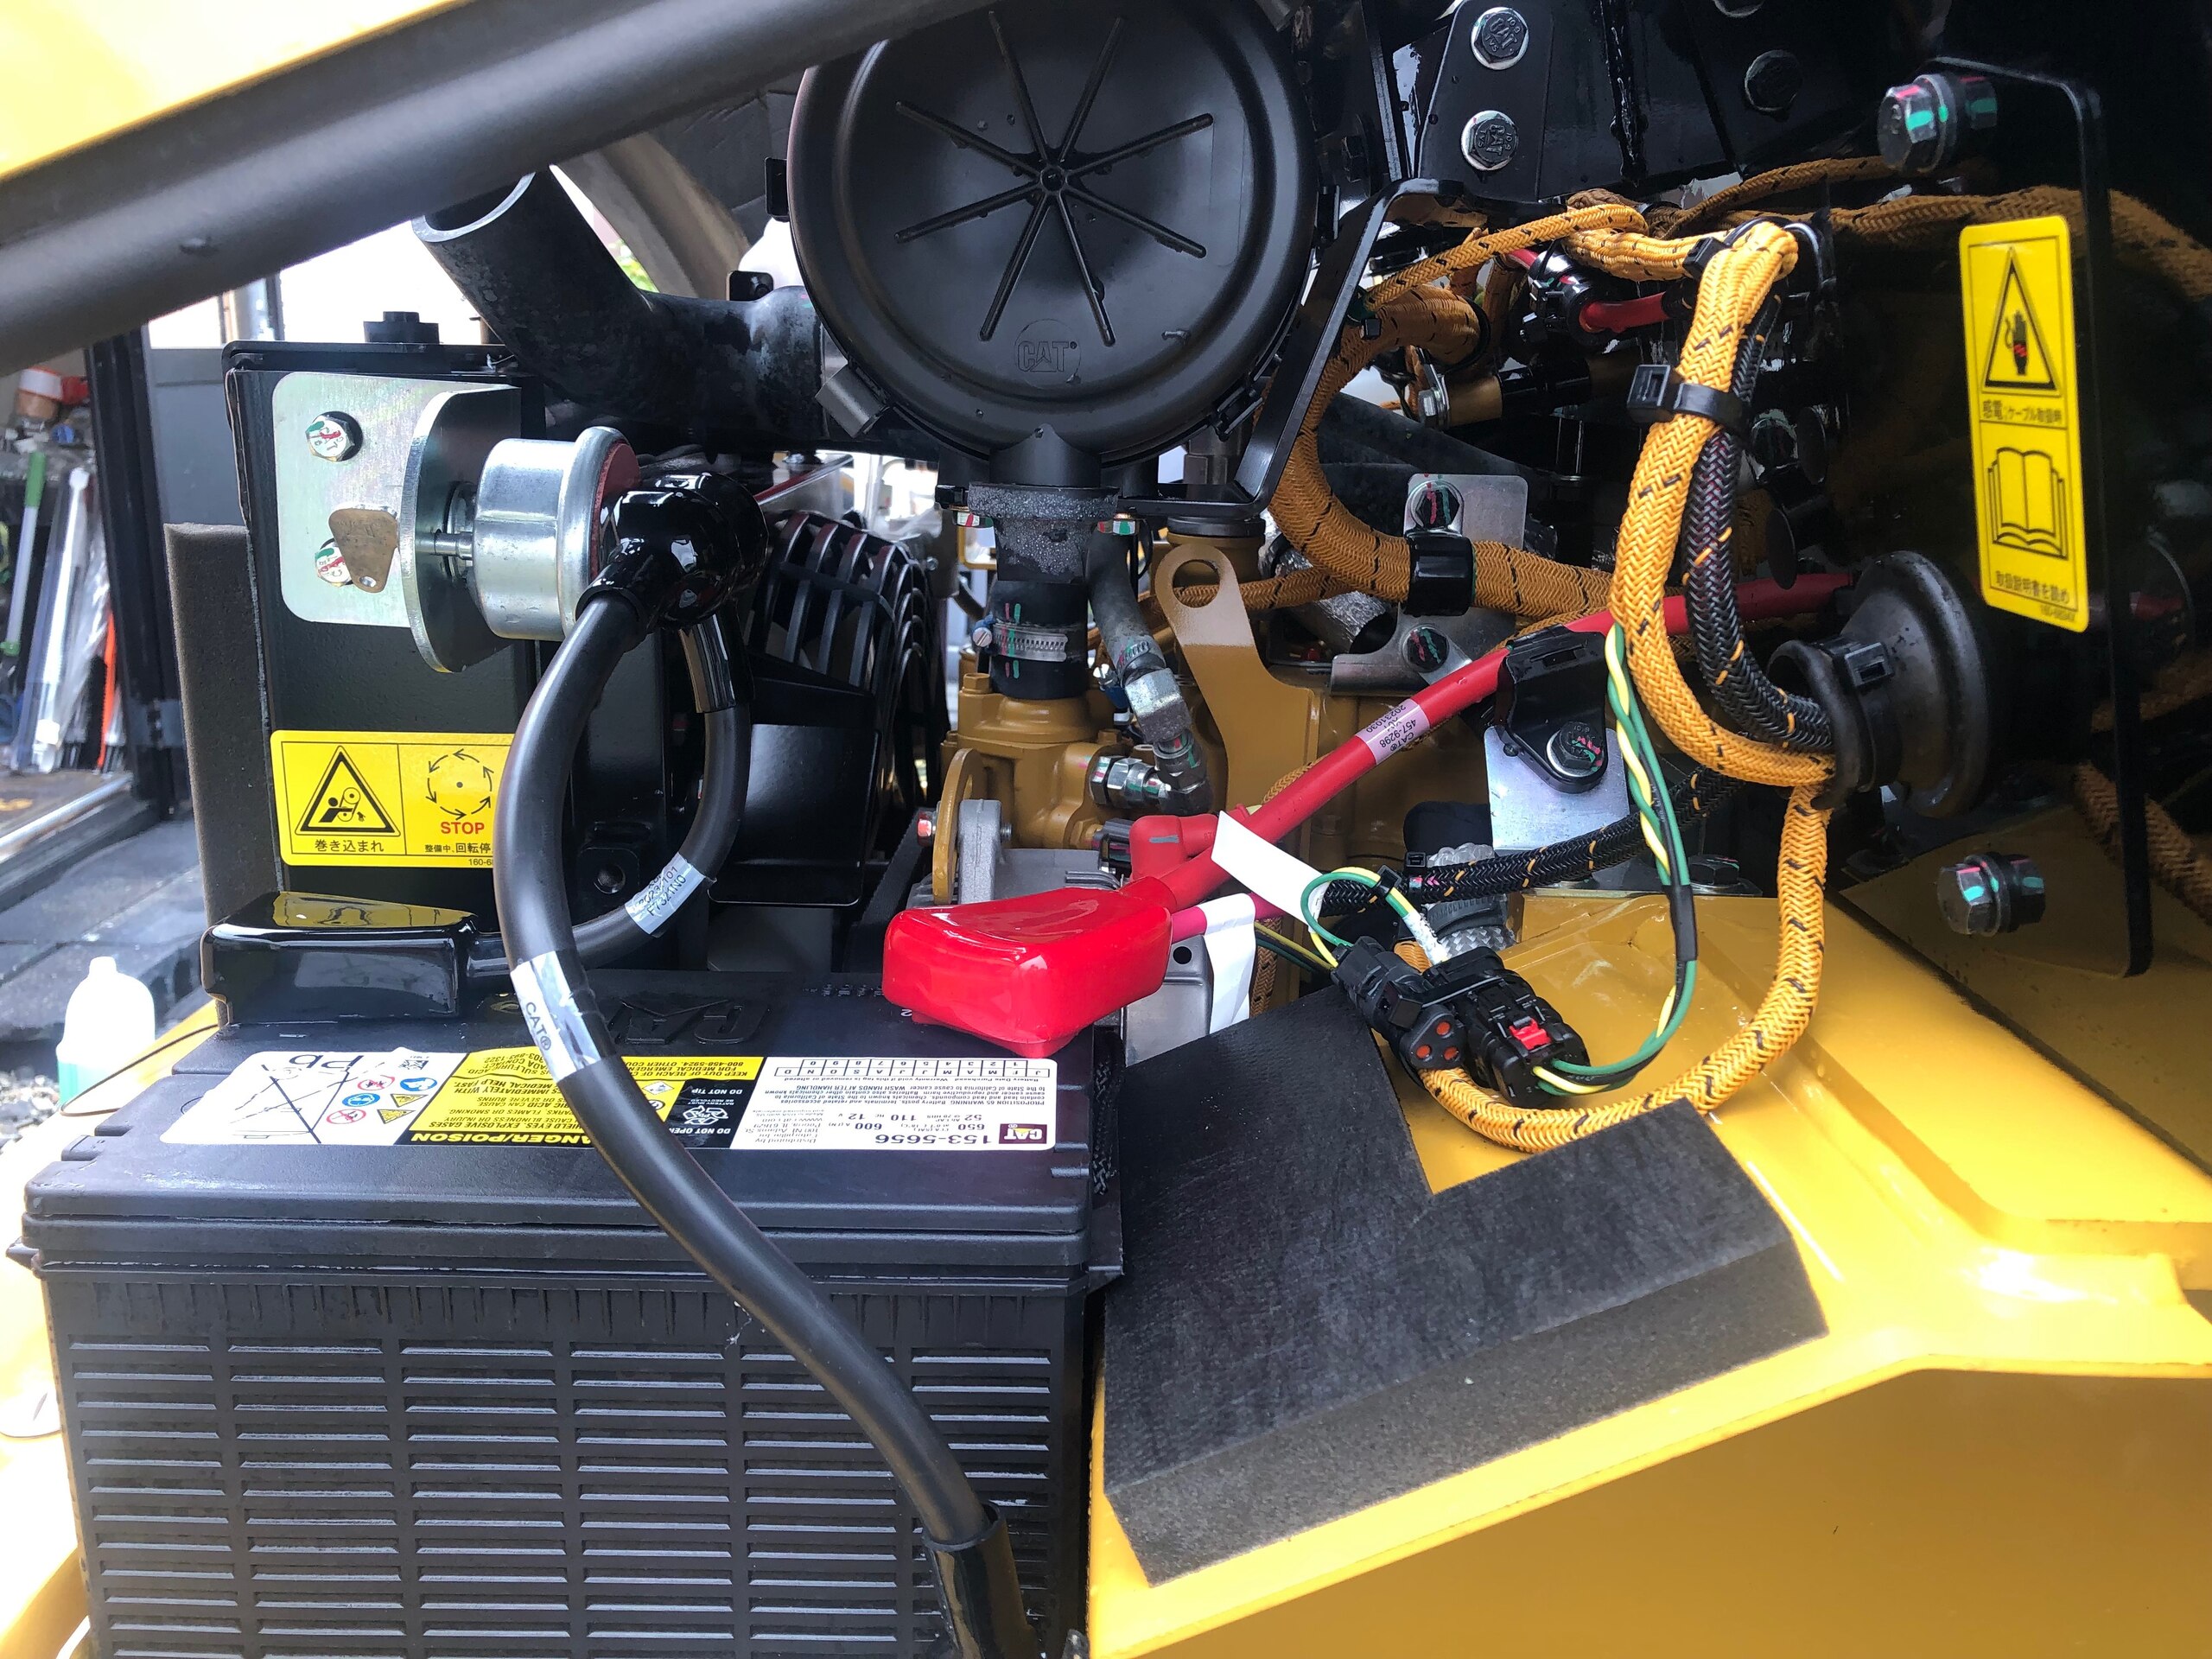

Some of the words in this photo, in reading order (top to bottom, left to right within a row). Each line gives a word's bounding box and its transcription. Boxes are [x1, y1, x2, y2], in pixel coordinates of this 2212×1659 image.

[1018, 340, 1070, 373] CAT
[1366, 704, 1407, 733] 20231030
[1379, 719, 1416, 748] 457-9298
[441, 821, 485, 835] STOP
[315, 838, 385, 854] 巻き込まれ
[424, 842, 493, 854] 整備中、回転停
[639, 866, 678, 906] 2023101
[289, 1054, 365, 1069] Pb
[410, 1133, 591, 1143] ANGER/POISON
[874, 1135, 992, 1144] 153-5656
[1003, 1128, 1042, 1140] CAT
